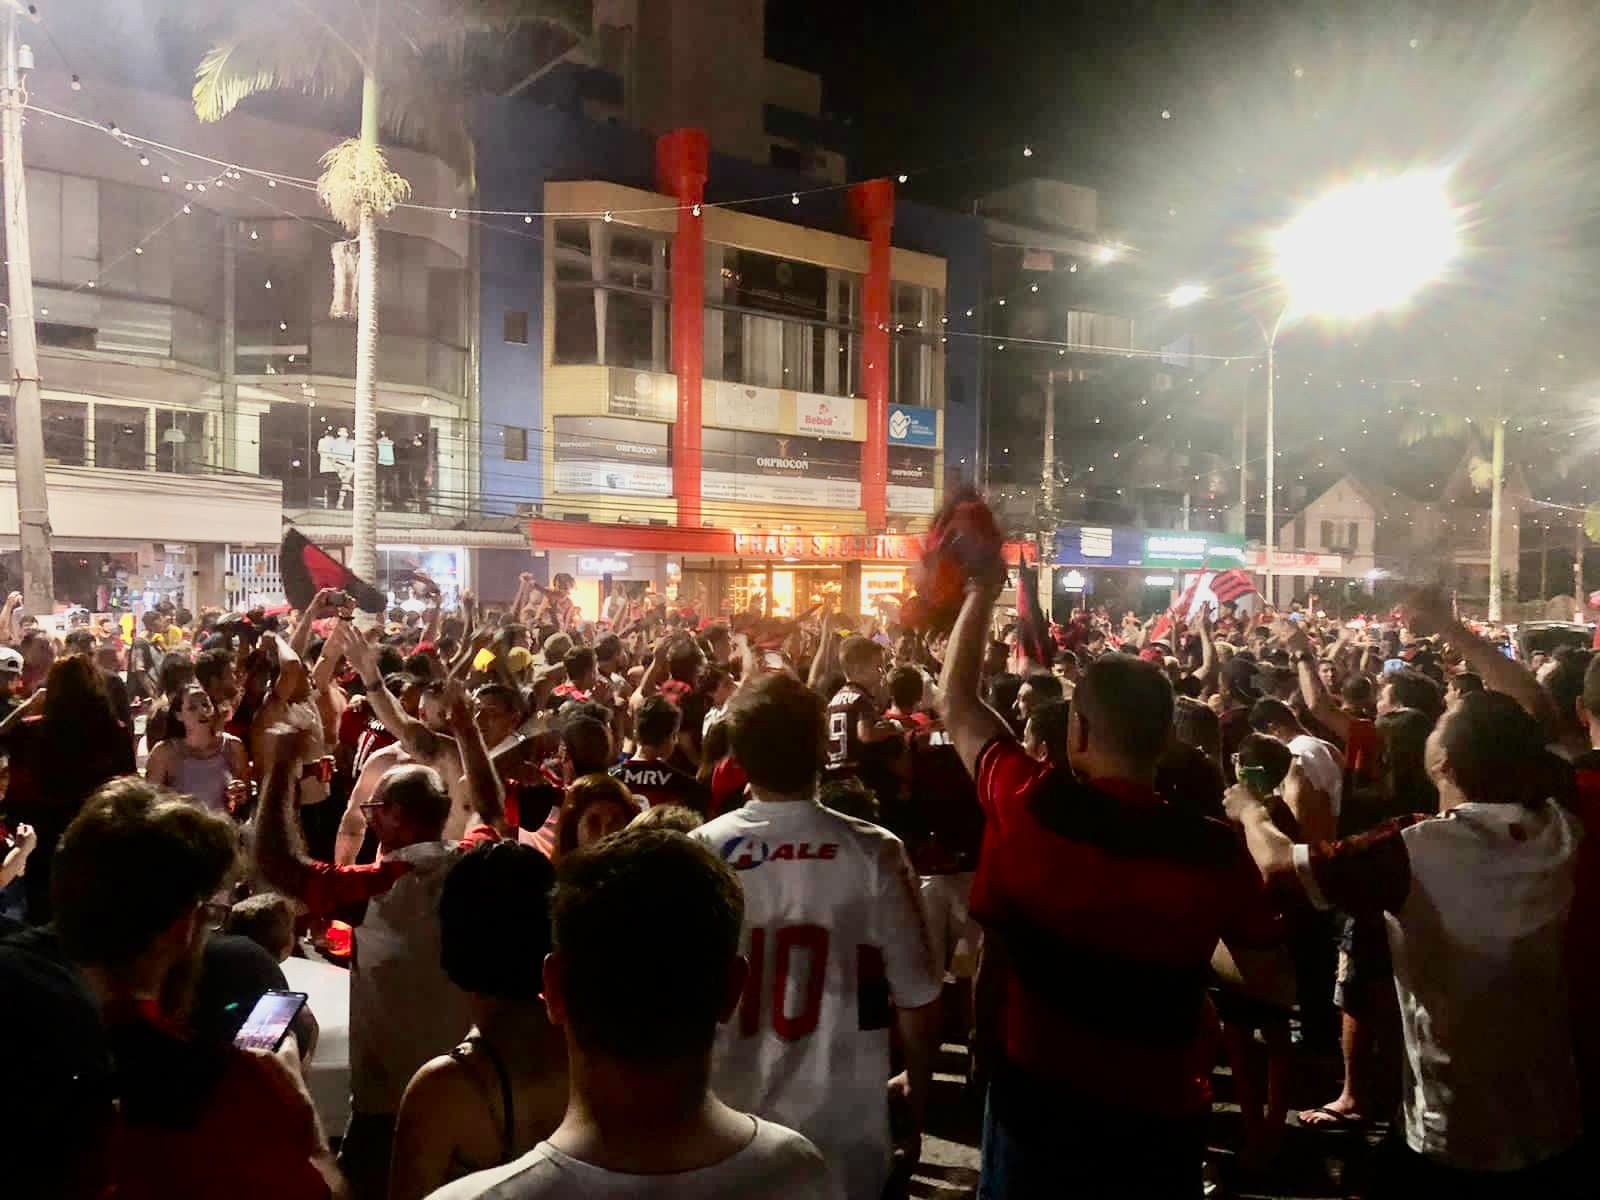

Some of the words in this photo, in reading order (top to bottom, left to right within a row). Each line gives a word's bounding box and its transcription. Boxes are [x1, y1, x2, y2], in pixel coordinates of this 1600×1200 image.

[623, 769, 673, 786] MRV
[769, 843, 842, 862] ALE
[738, 923, 831, 1042] 10
